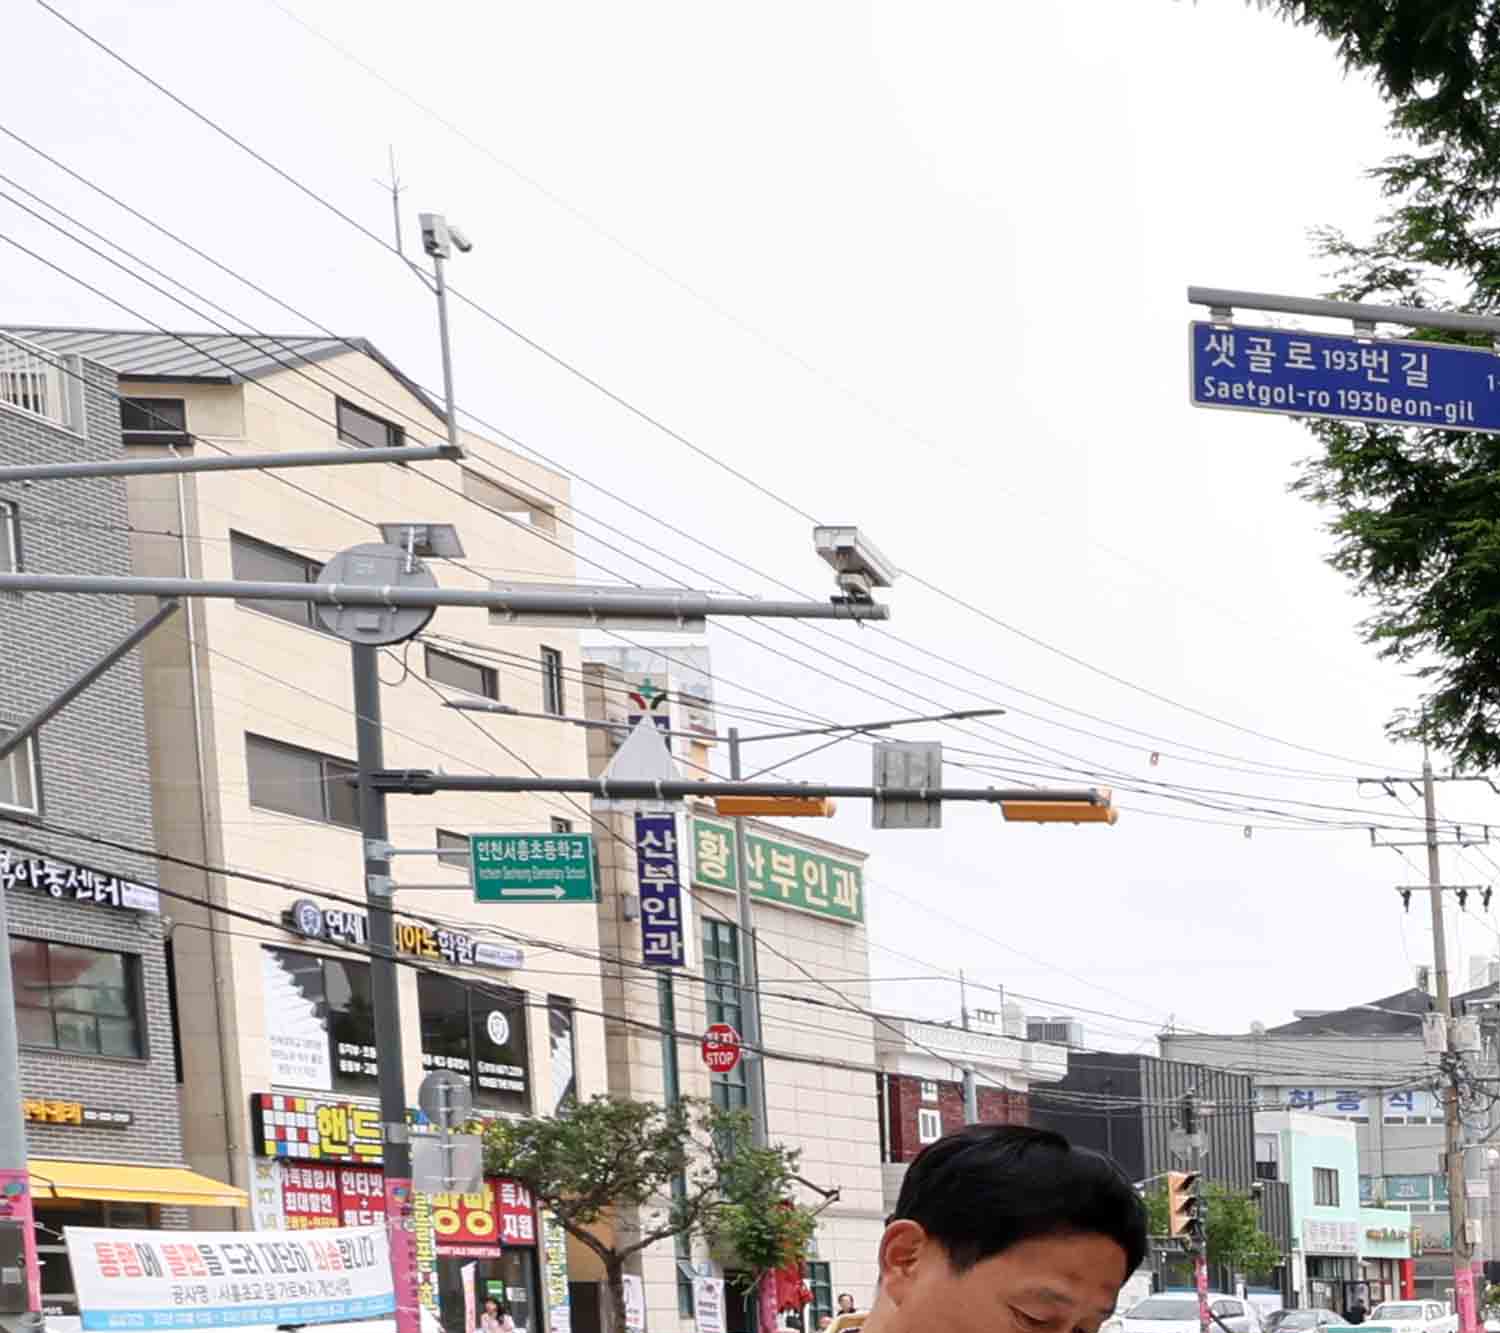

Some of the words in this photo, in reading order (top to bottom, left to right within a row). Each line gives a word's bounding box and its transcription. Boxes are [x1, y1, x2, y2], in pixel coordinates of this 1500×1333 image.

[1203, 375, 1330, 408] Saetgol-ro
[1337, 388, 1476, 423] 193beon-gil
[477, 838, 585, 862] 인천서흥초등학교
[326, 910, 368, 945] 연세
[395, 920, 475, 965] 아노학원
[706, 1051, 734, 1066] STOP
